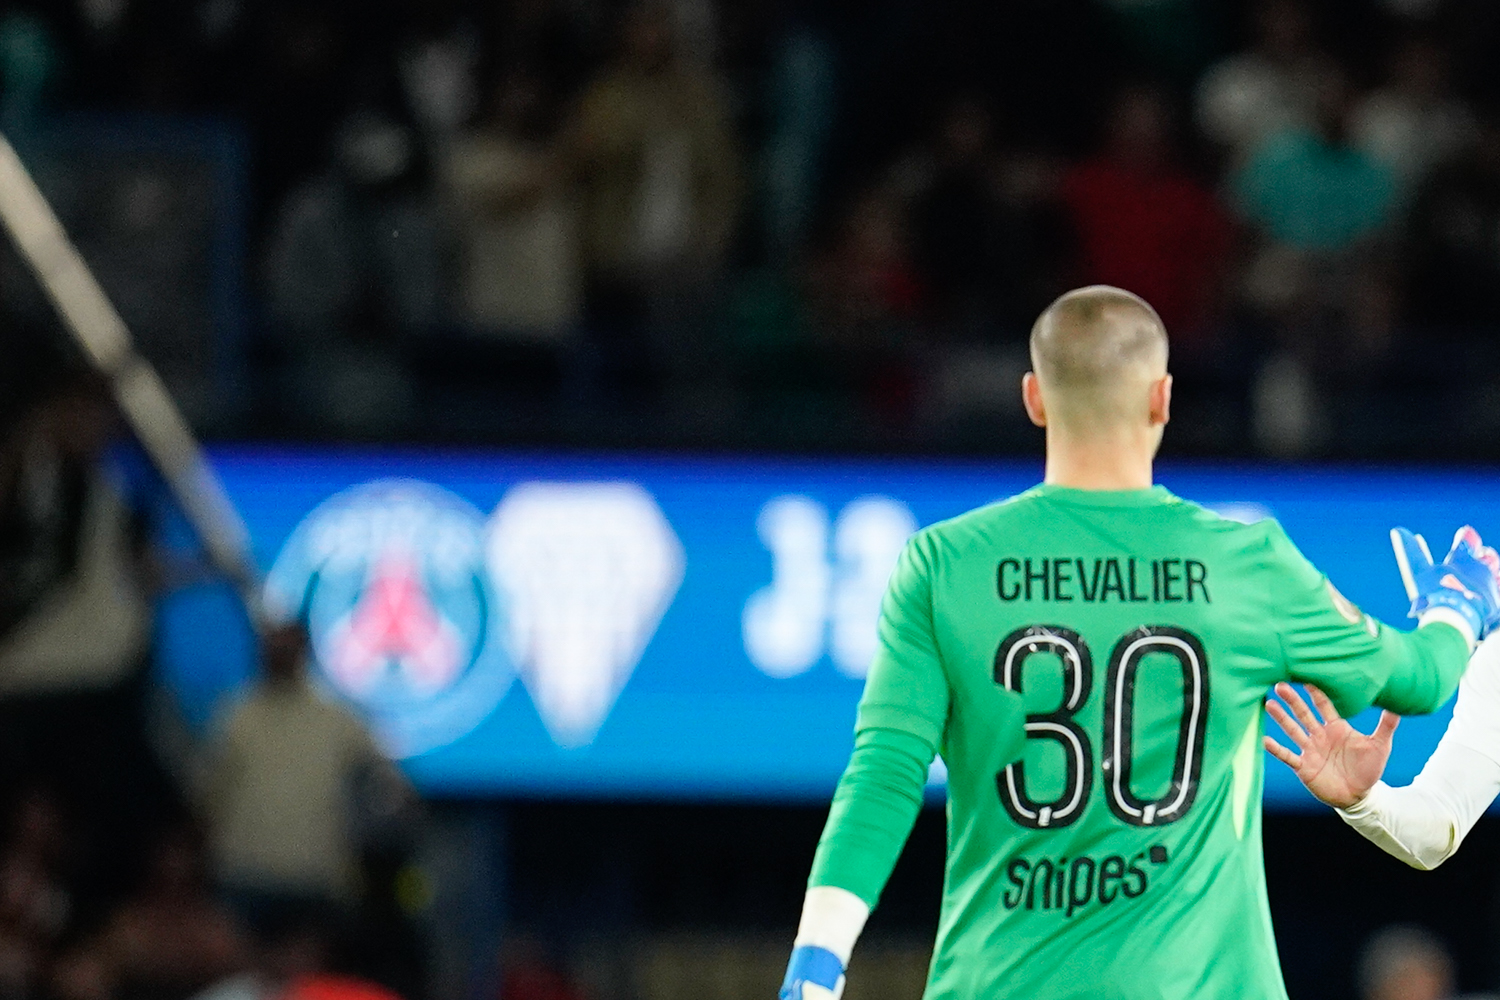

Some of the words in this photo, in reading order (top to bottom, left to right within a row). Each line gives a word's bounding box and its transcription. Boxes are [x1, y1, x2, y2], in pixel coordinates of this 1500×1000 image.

[996, 557, 1211, 604] CHEVALIER
[993, 624, 1210, 830] 30
[1003, 853, 1149, 917] snipes
